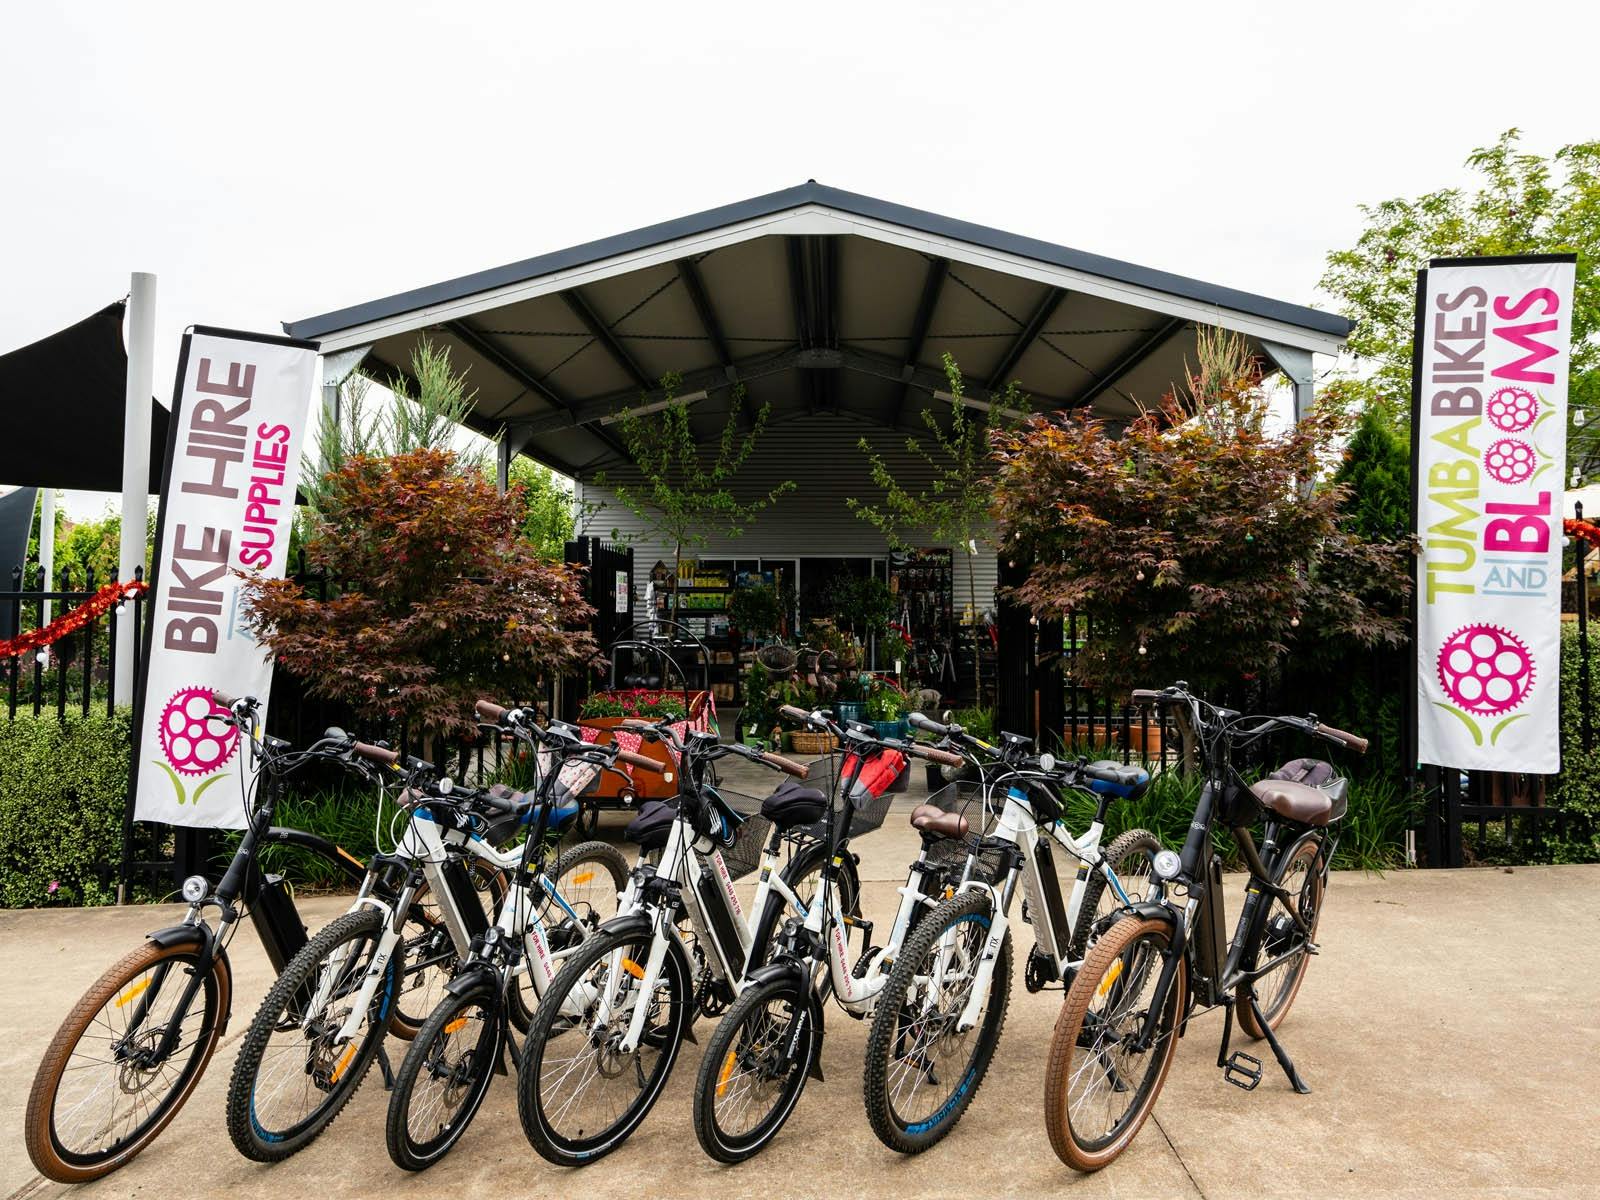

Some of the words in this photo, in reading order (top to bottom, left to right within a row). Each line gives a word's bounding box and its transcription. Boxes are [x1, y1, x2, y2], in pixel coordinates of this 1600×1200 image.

[1431, 286, 1488, 416] BIKES
[182, 357, 256, 499] HIRE
[239, 422, 290, 568] SUPPLIES
[1426, 416, 1482, 604] TUMBA
[165, 524, 232, 654] BIKE
[1483, 566, 1547, 590] AND
[720, 866, 728, 879] HIRE
[531, 931, 540, 944] FOR
[537, 944, 545, 959] HIRE
